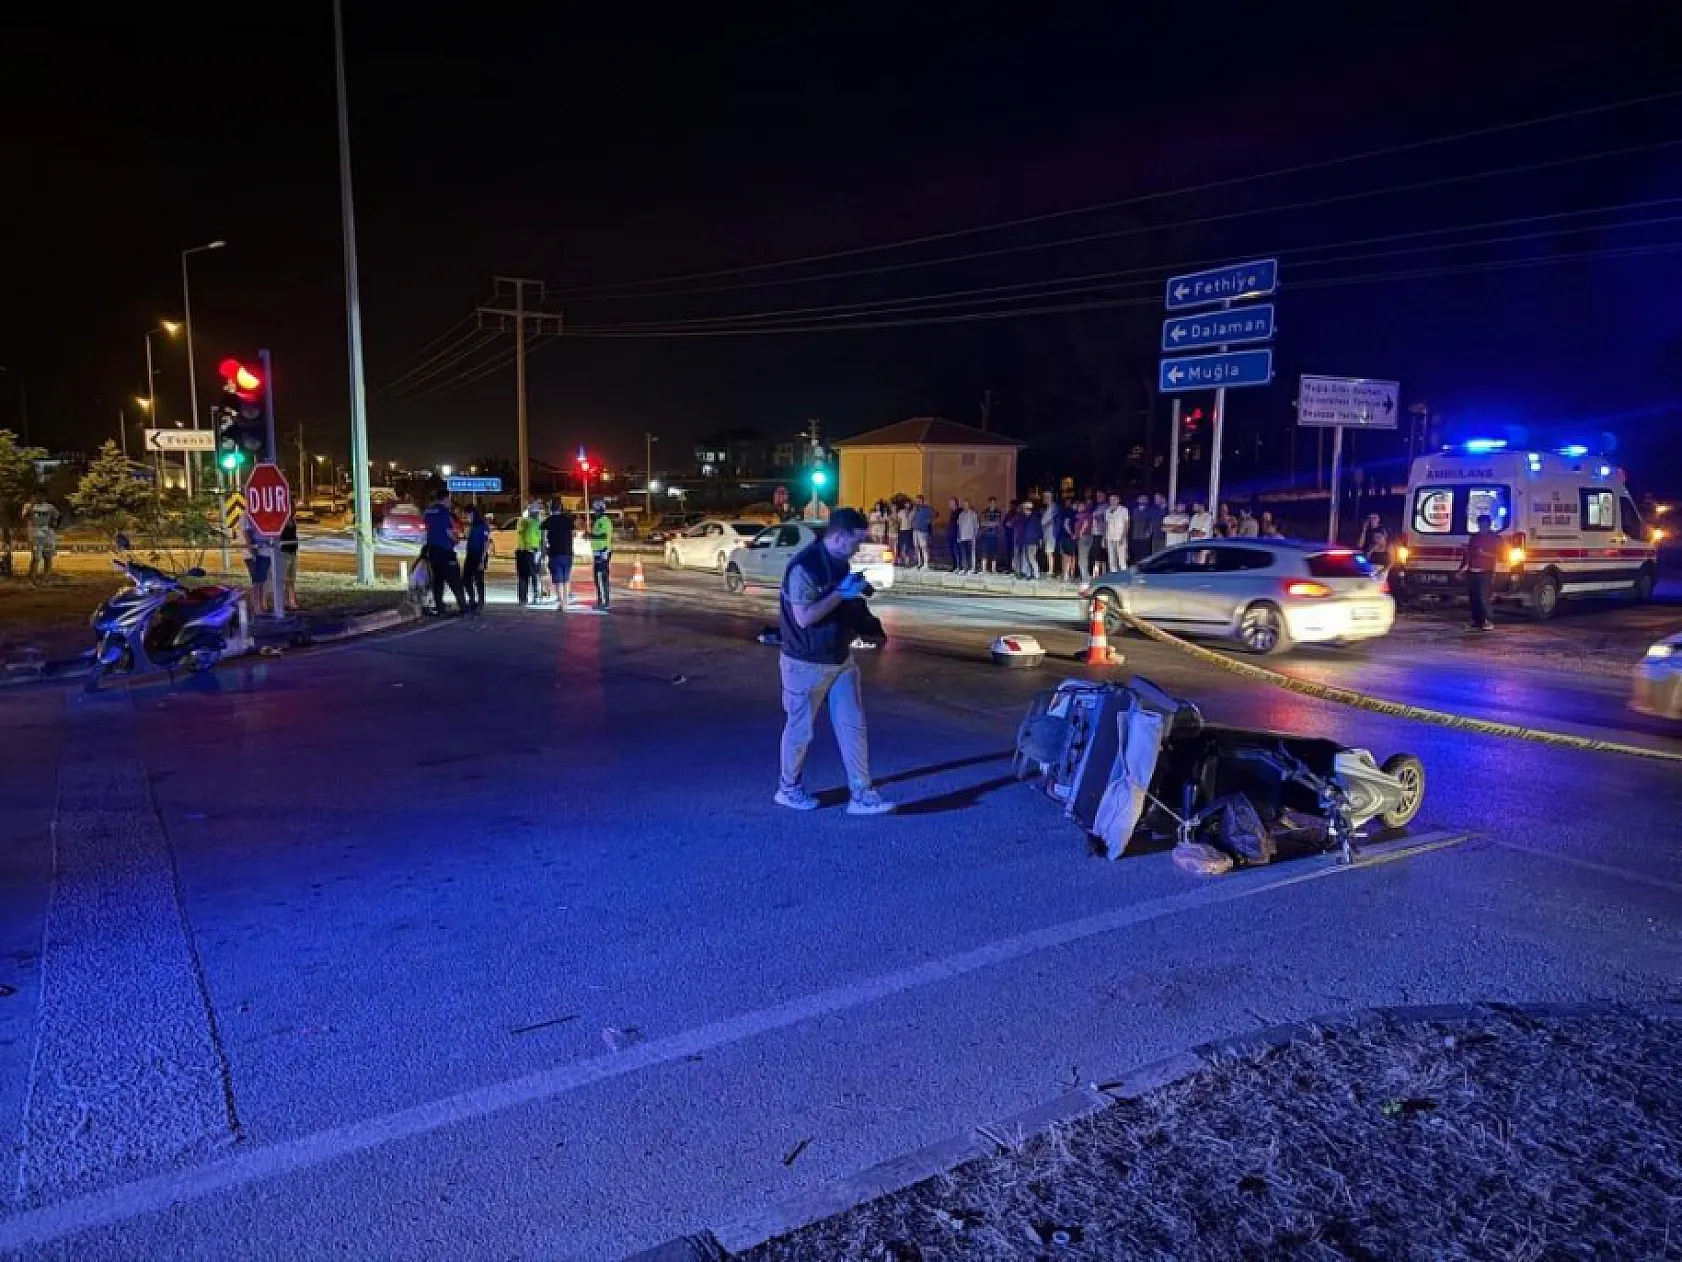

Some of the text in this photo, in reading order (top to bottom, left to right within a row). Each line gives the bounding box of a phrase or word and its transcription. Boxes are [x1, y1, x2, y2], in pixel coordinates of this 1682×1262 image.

[1194, 274, 1256, 296] Fethiye
[1191, 319, 1265, 338] Dalaman
[1188, 363, 1240, 381] Muğla
[250, 485, 286, 513] DUR
